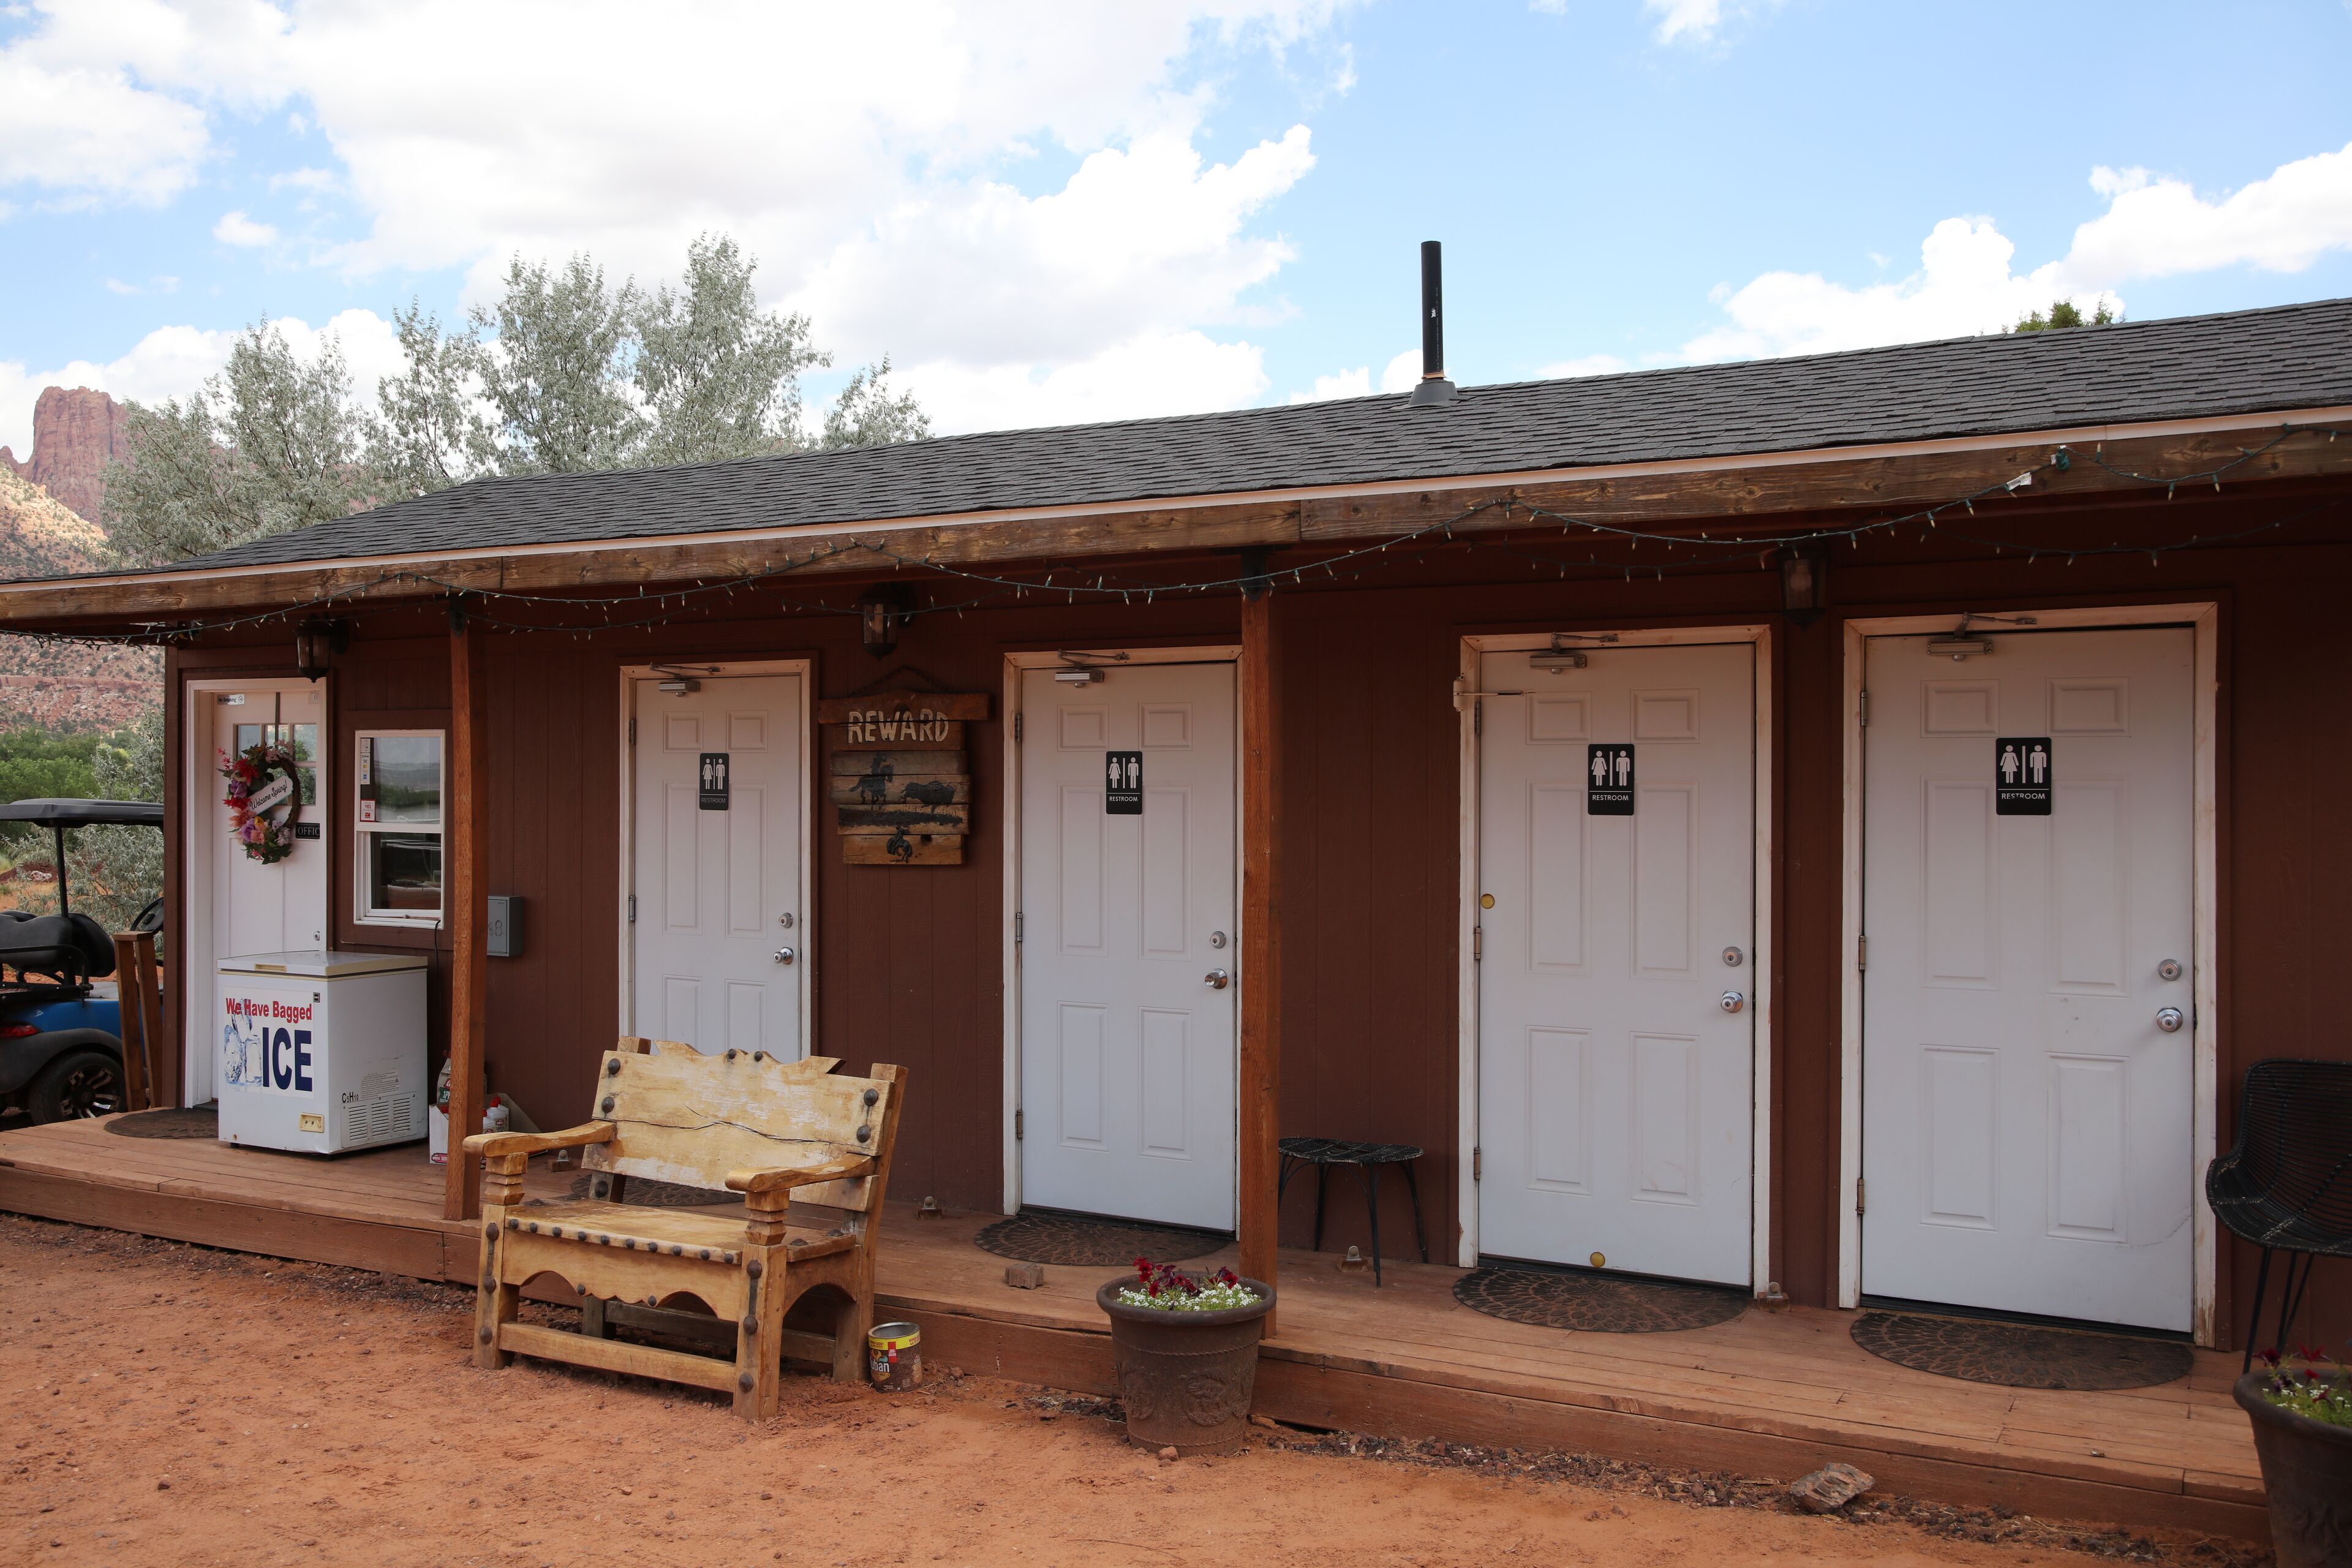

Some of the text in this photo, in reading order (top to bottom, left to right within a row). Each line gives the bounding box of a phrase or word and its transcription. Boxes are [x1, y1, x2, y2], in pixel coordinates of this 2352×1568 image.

[848, 708, 949, 745] REWARD
[249, 778, 288, 810] Welcome Spring!
[298, 826, 320, 836] OFFIC
[225, 998, 312, 1023] We Have Bagged
[262, 1027, 313, 1092] ICE
